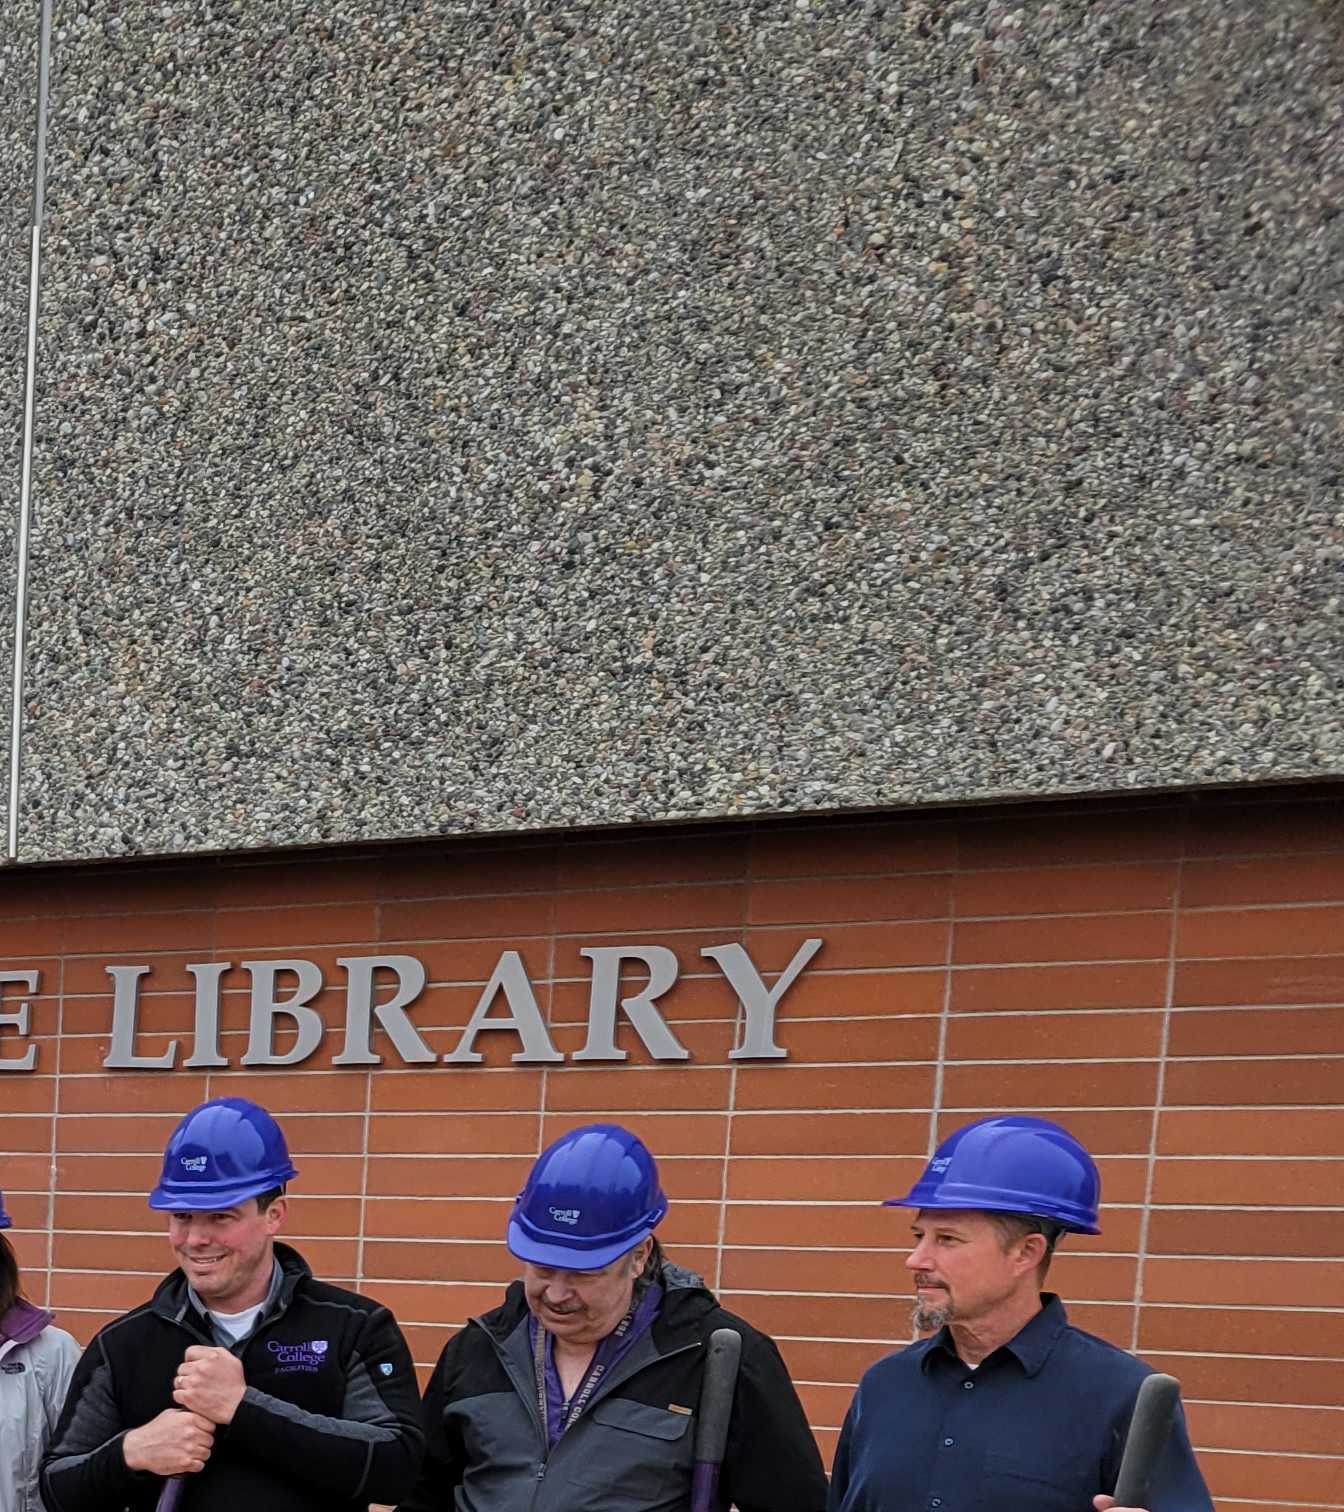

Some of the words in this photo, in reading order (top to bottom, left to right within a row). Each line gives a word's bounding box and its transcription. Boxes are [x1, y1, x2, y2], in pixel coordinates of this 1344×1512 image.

[102, 937, 824, 1070] LIBRARY
[267, 1341, 312, 1352] Carroll
[278, 1352, 325, 1366] College
